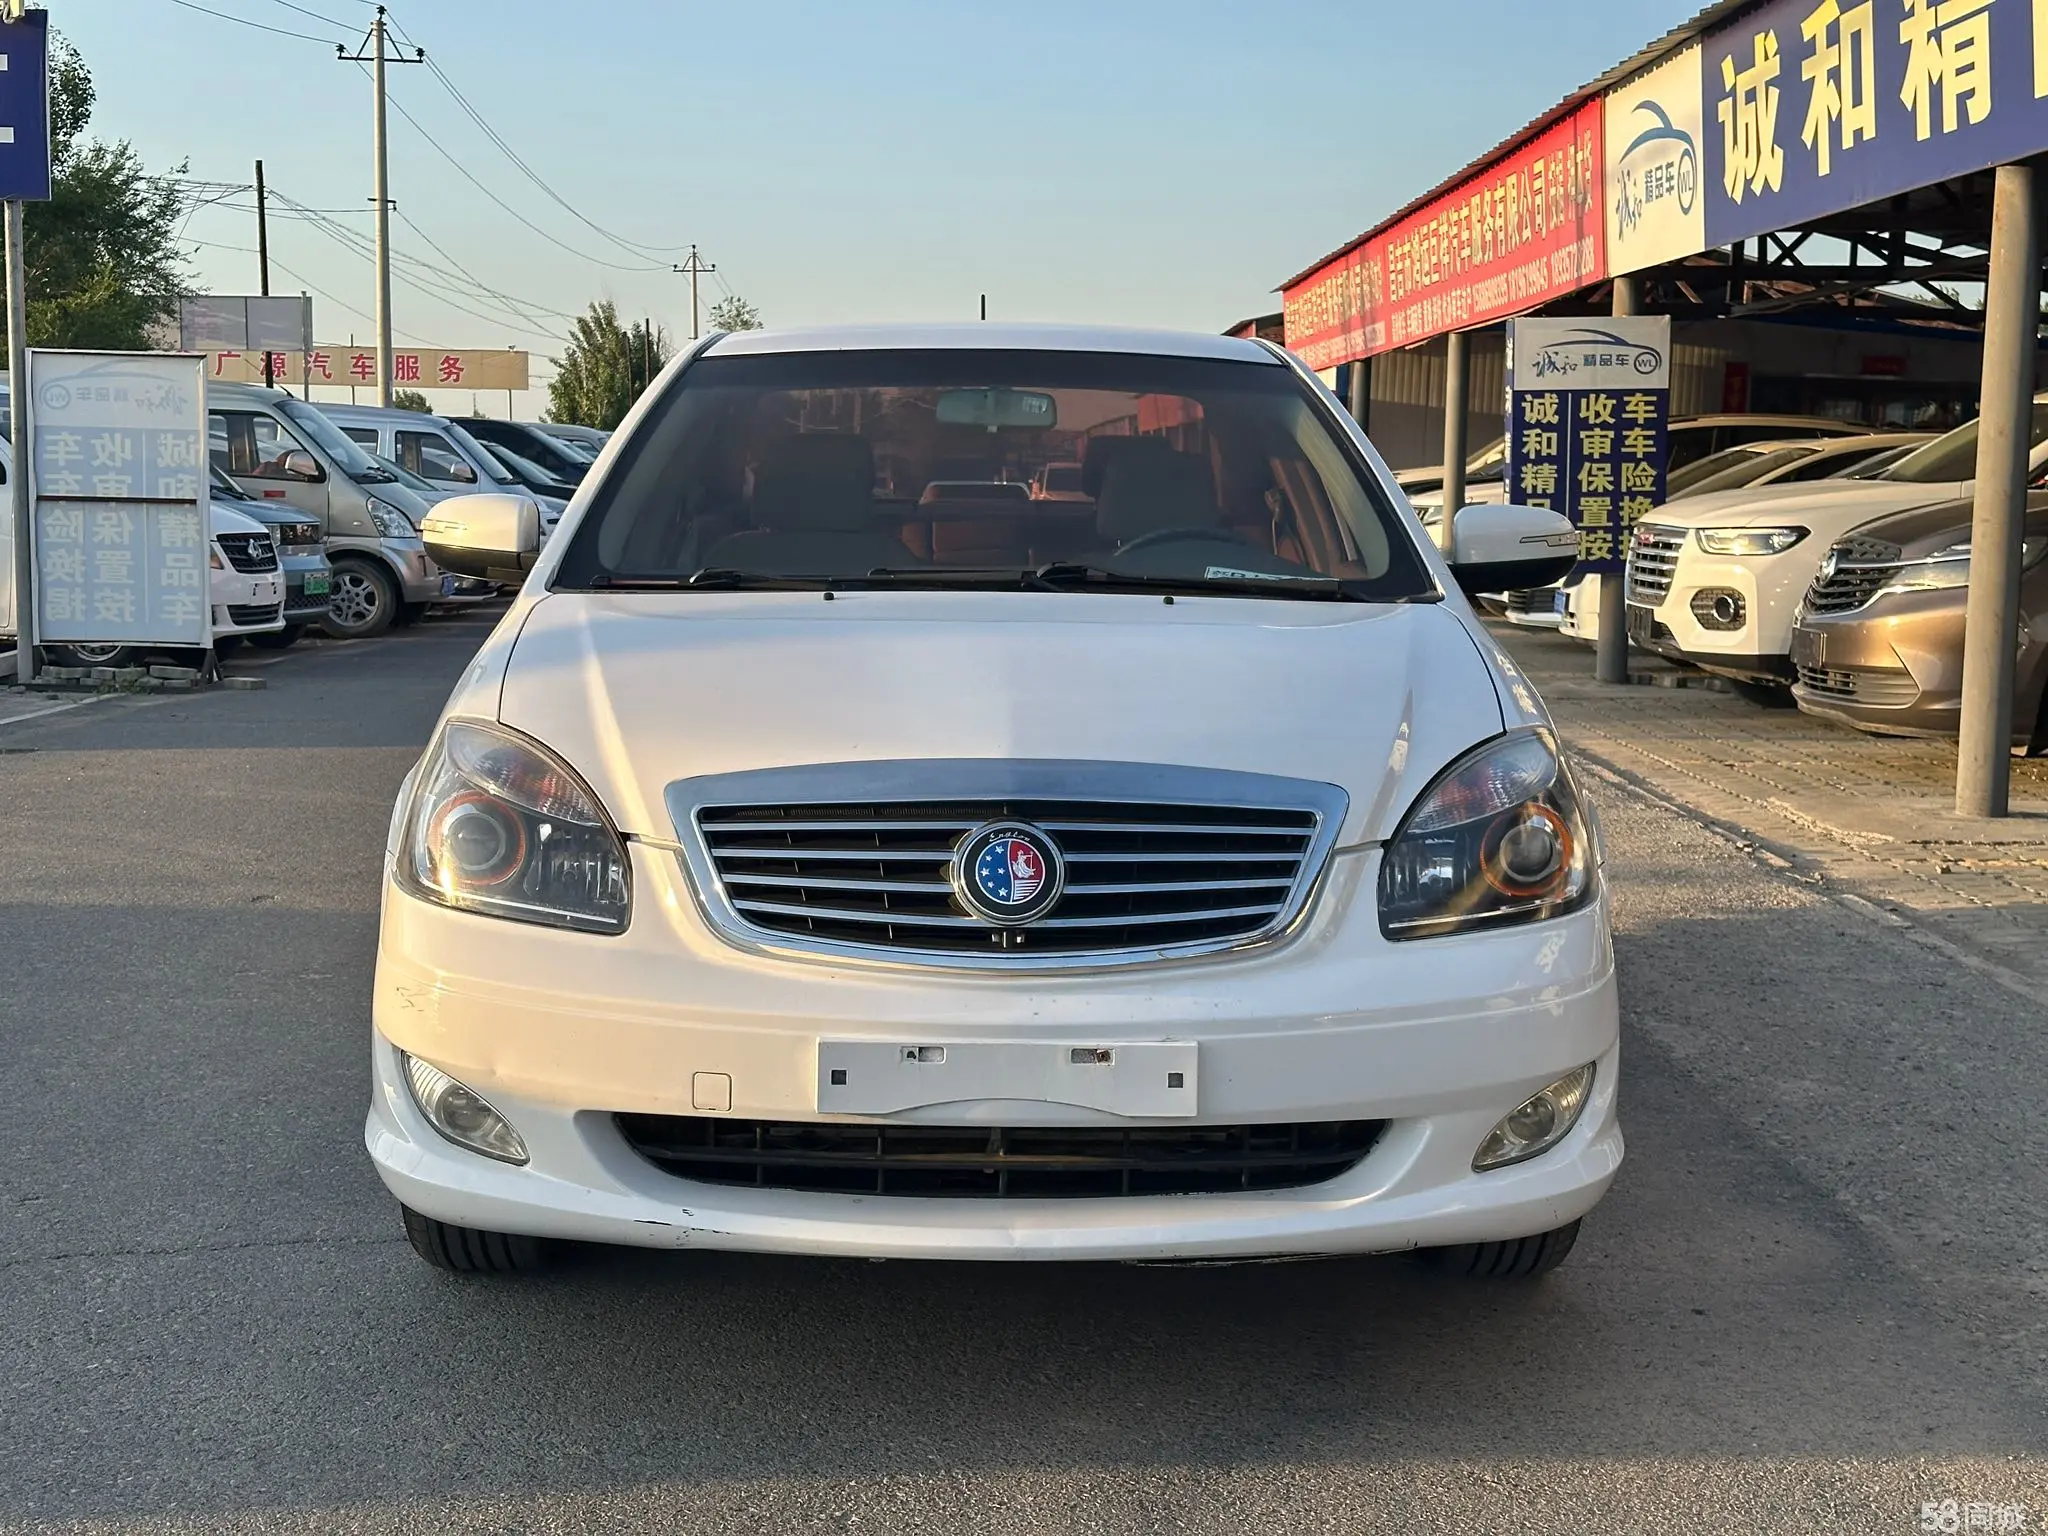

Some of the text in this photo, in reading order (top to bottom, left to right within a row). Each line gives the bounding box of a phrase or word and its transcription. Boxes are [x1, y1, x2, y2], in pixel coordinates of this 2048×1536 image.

[1717, 0, 2048, 206] 诚和精
[1644, 161, 1675, 204] 精品车
[1583, 354, 1629, 367] 精品车
